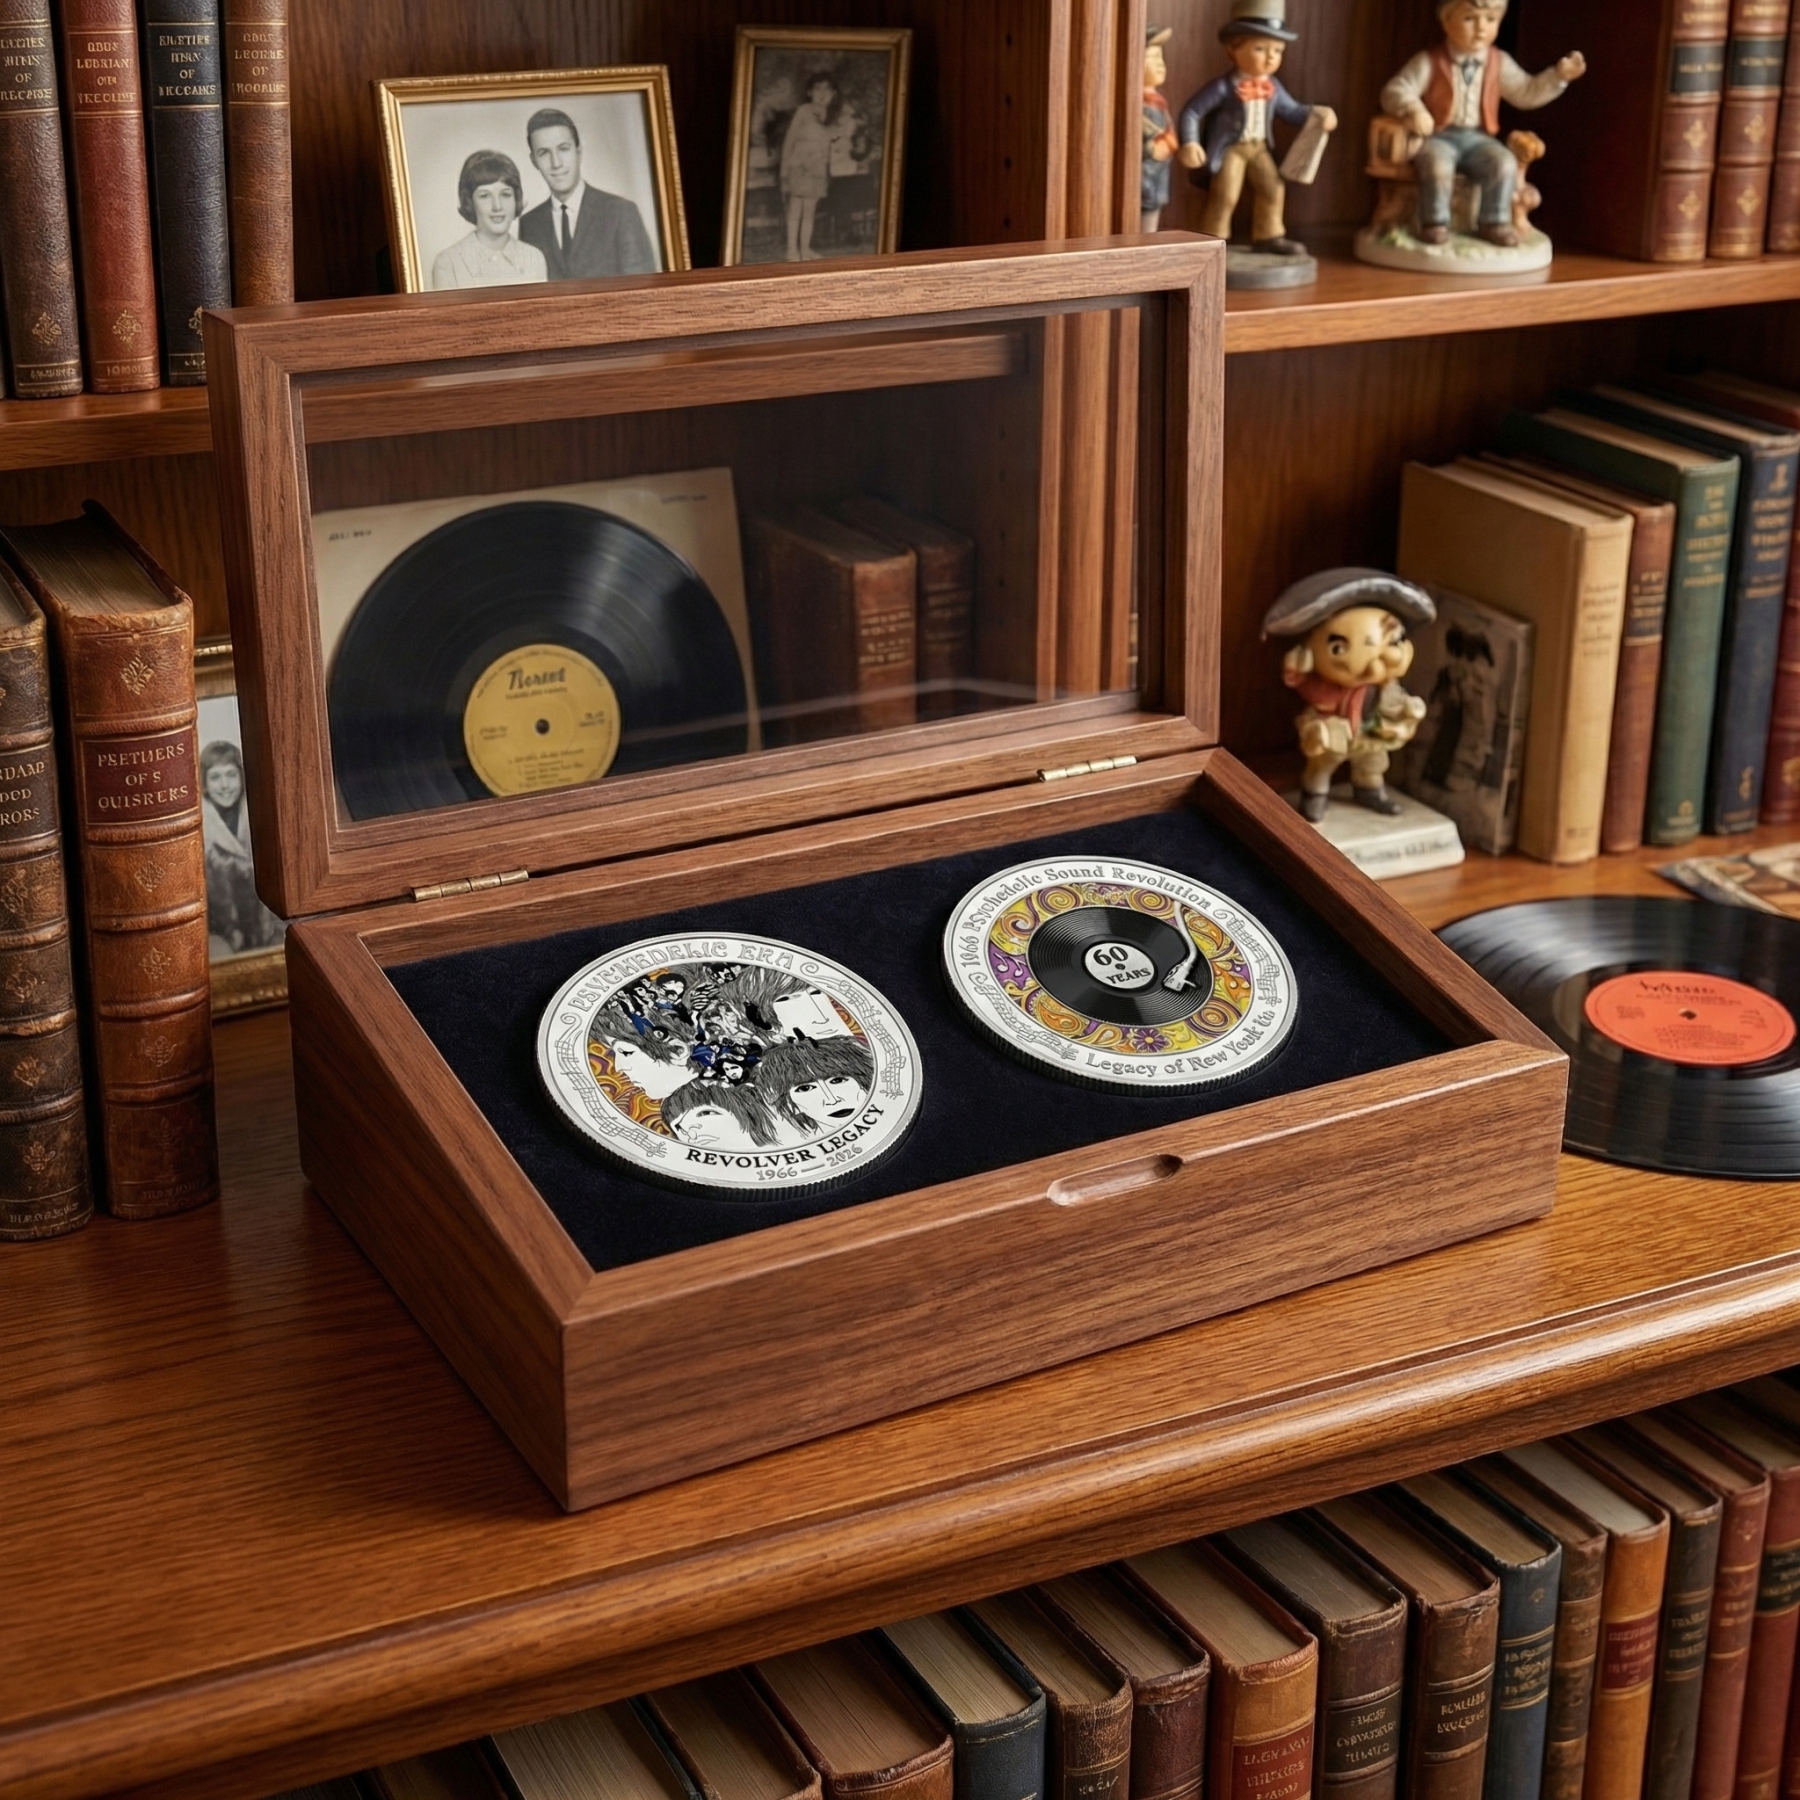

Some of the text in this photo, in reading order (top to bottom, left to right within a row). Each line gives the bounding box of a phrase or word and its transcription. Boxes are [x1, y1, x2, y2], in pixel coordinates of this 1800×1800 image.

[179, 69, 196, 79] OF
[125, 773, 148, 786] OF
[958, 935, 981, 968] 1966
[1044, 865, 1106, 881] Sound
[1112, 866, 1212, 911] Revolution
[737, 943, 795, 969] ERA
[1093, 946, 1129, 966] 60
[1106, 968, 1152, 985] YEARS
[1085, 1052, 1157, 1077] Legacy
[1164, 1059, 1185, 1075] of
[684, 1104, 885, 1169] REVOLVER LEGACY
[756, 1166, 798, 1181] 1966
[826, 1144, 864, 1167] 2026
